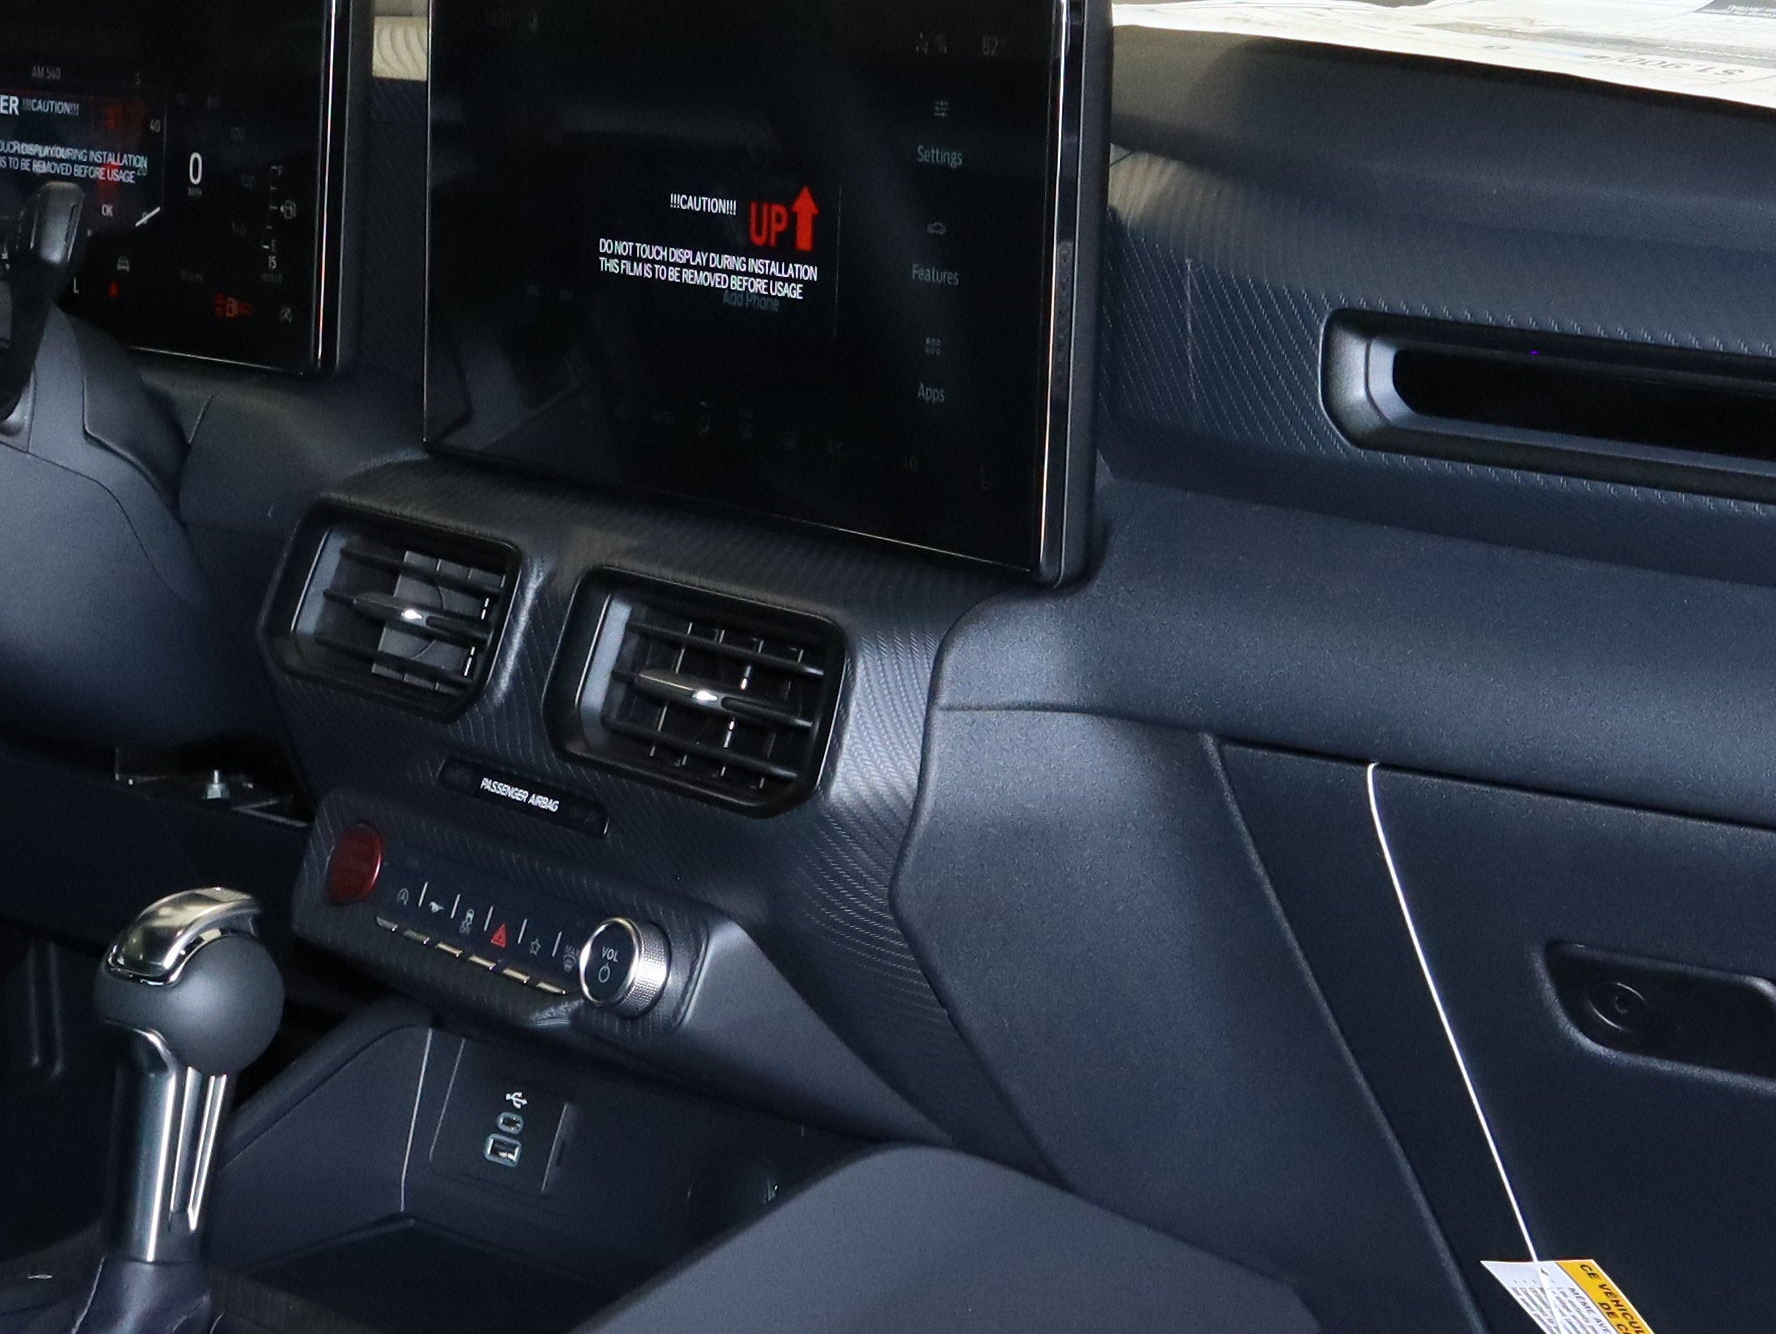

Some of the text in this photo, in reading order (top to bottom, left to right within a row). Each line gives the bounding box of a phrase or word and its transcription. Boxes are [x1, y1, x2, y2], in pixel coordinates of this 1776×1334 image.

[149, 117, 160, 132] 40
[89, 149, 147, 168] INSTALLATION
[188, 151, 203, 185] 0
[916, 144, 962, 169] Settings
[0, 155, 6, 168] IS
[8, 156, 18, 170] TO
[20, 158, 31, 172] BE
[32, 159, 72, 175] REMOVED
[73, 163, 106, 179] BEFORE
[107, 168, 135, 183] USAGE
[101, 203, 113, 216] OK
[670, 193, 737, 216] !!!CAUTION!!!
[748, 201, 788, 248] UP
[598, 238, 817, 281] DO NOT TOUCH DISPLAY DURING INSTALLATION
[599, 257, 803, 299] THIS FILM IS TO BE REMOVED BEFORE USAGE
[911, 263, 959, 286] Features
[722, 290, 779, 312] Add Phone
[917, 381, 945, 403] Apps
[479, 776, 560, 813] PASSENGER AIRBAG
[601, 946, 618, 962] VOL
[1580, 1264, 1600, 1280] CE
[1600, 1303, 1619, 1318] DE
